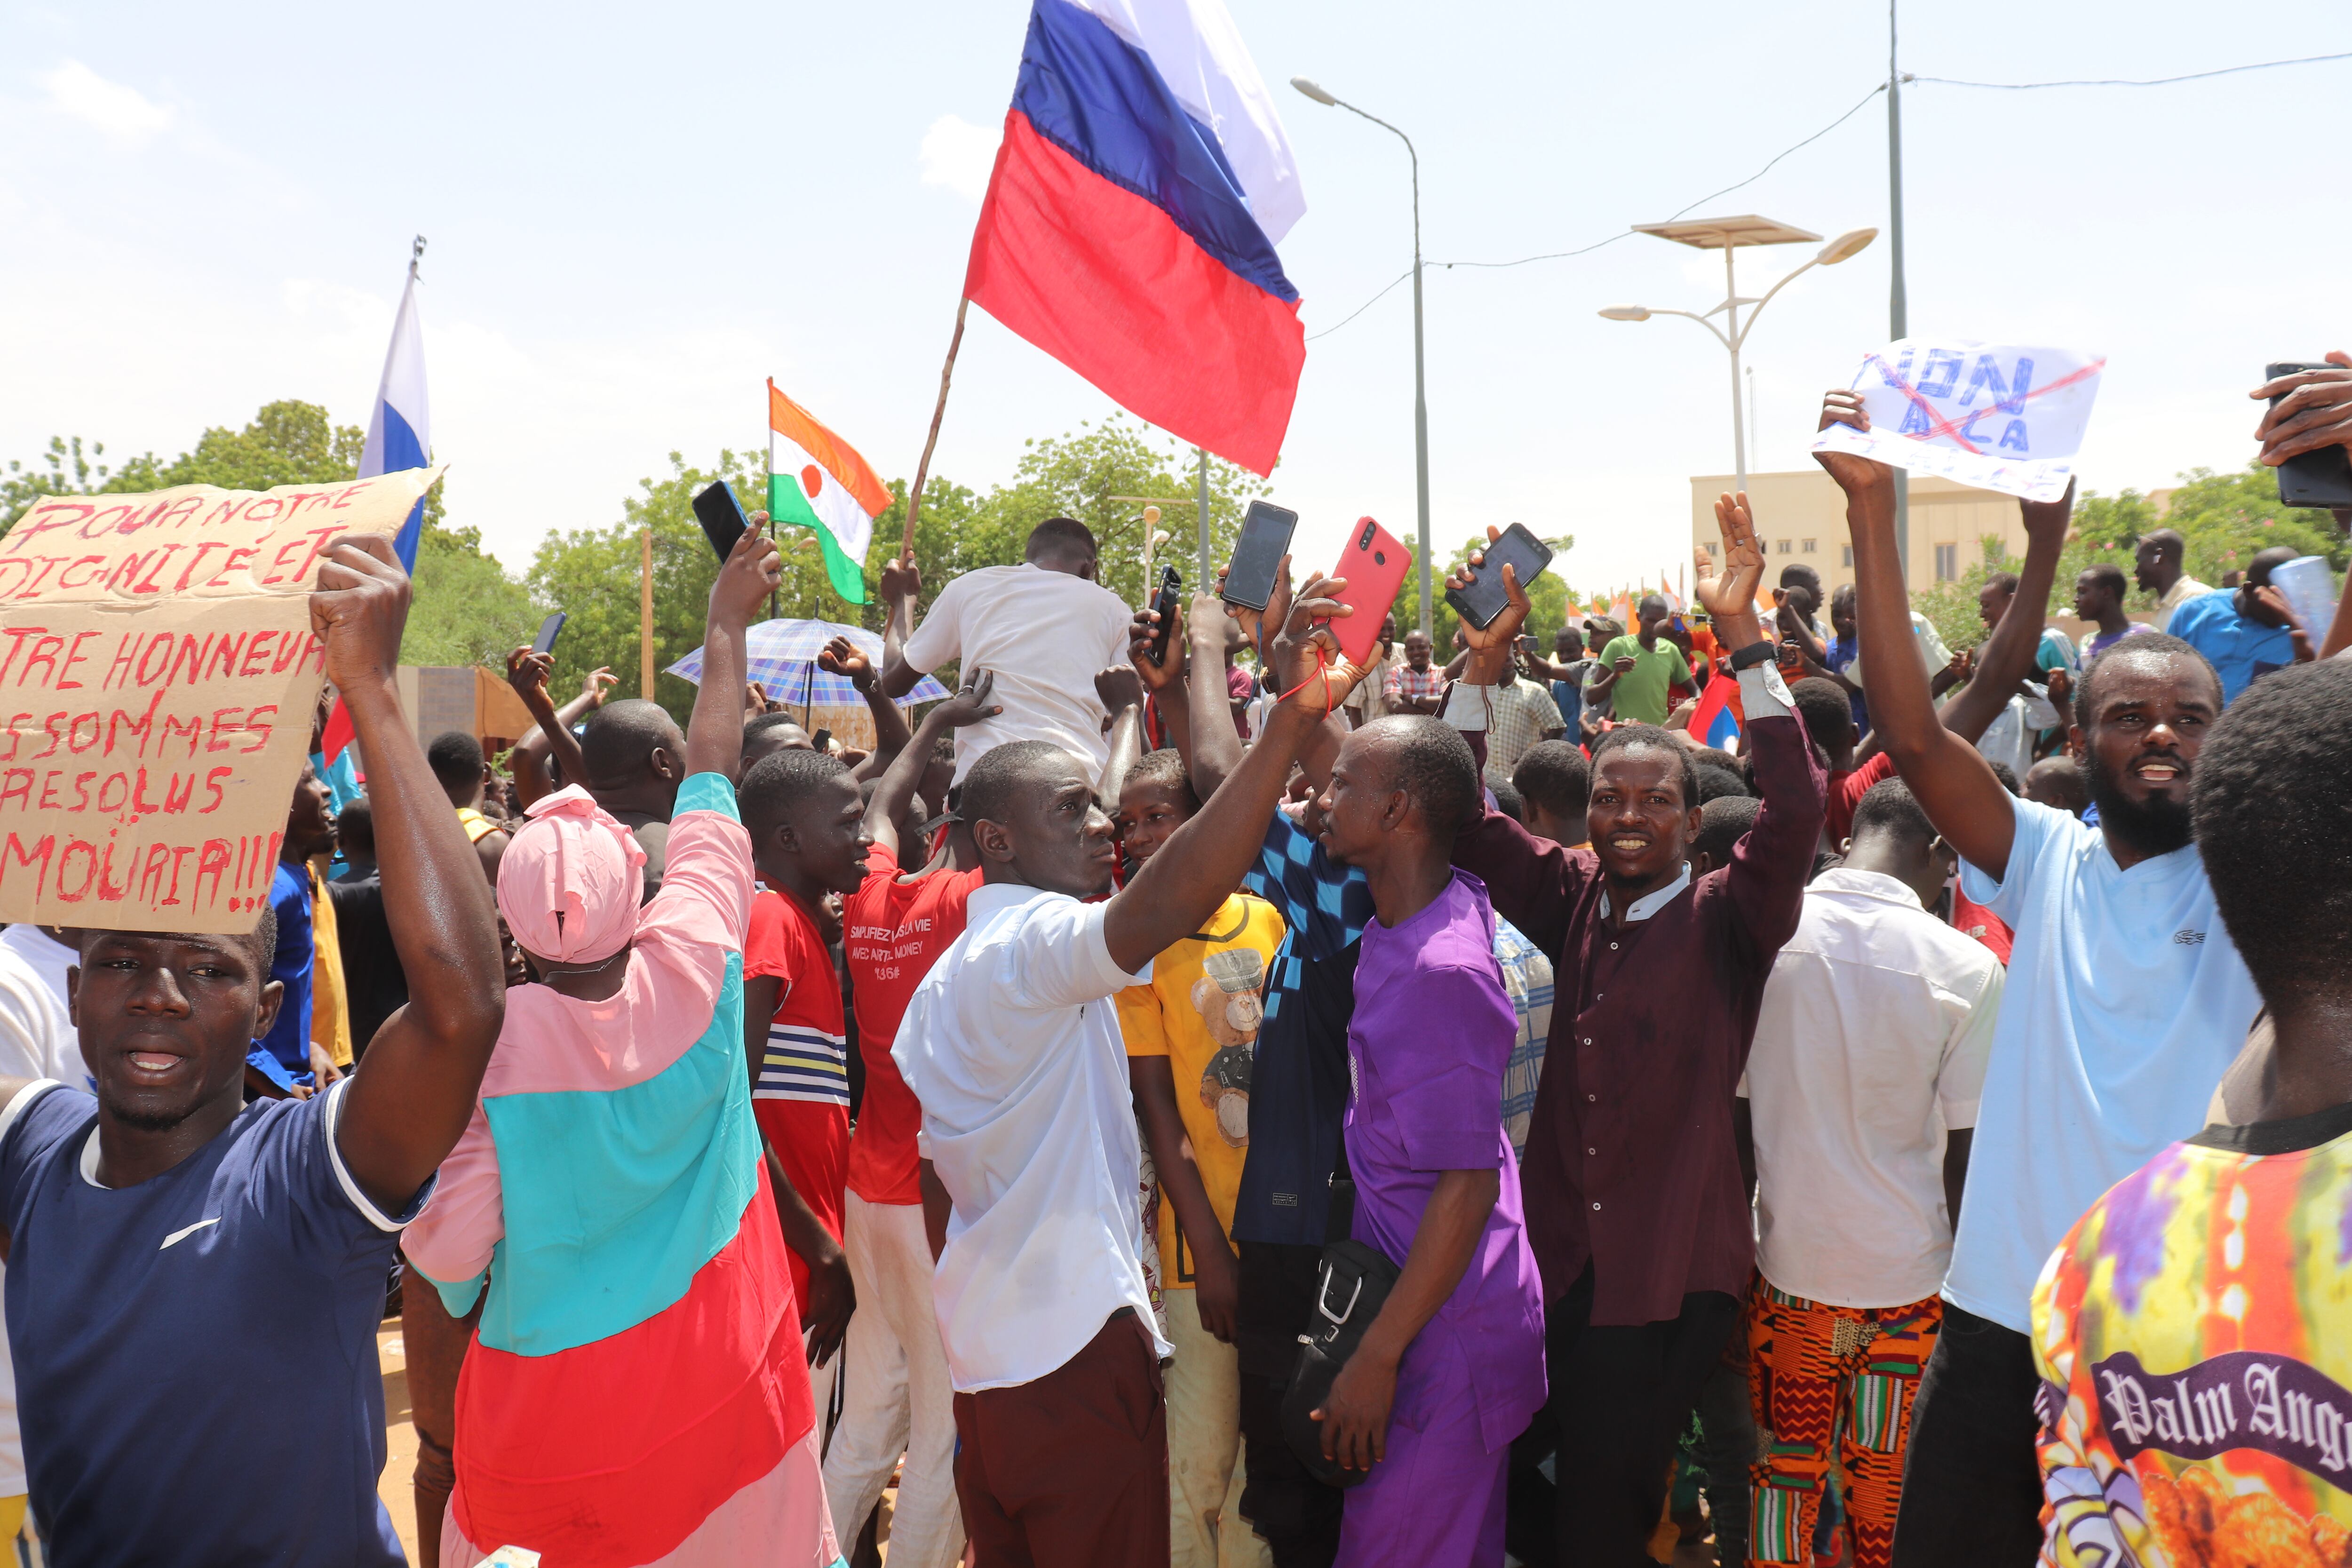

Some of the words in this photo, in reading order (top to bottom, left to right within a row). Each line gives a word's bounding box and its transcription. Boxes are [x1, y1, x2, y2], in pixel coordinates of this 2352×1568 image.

[201, 482, 375, 526] NOTRE
[261, 525, 349, 584] ET
[850, 925, 891, 941] SIMPLIFIEZ
[904, 921, 913, 935] LA
[914, 918, 931, 932] VIE
[852, 946, 869, 960] AVEC
[895, 940, 923, 959] MONEY
[2100, 1369, 2238, 1445] Palm
